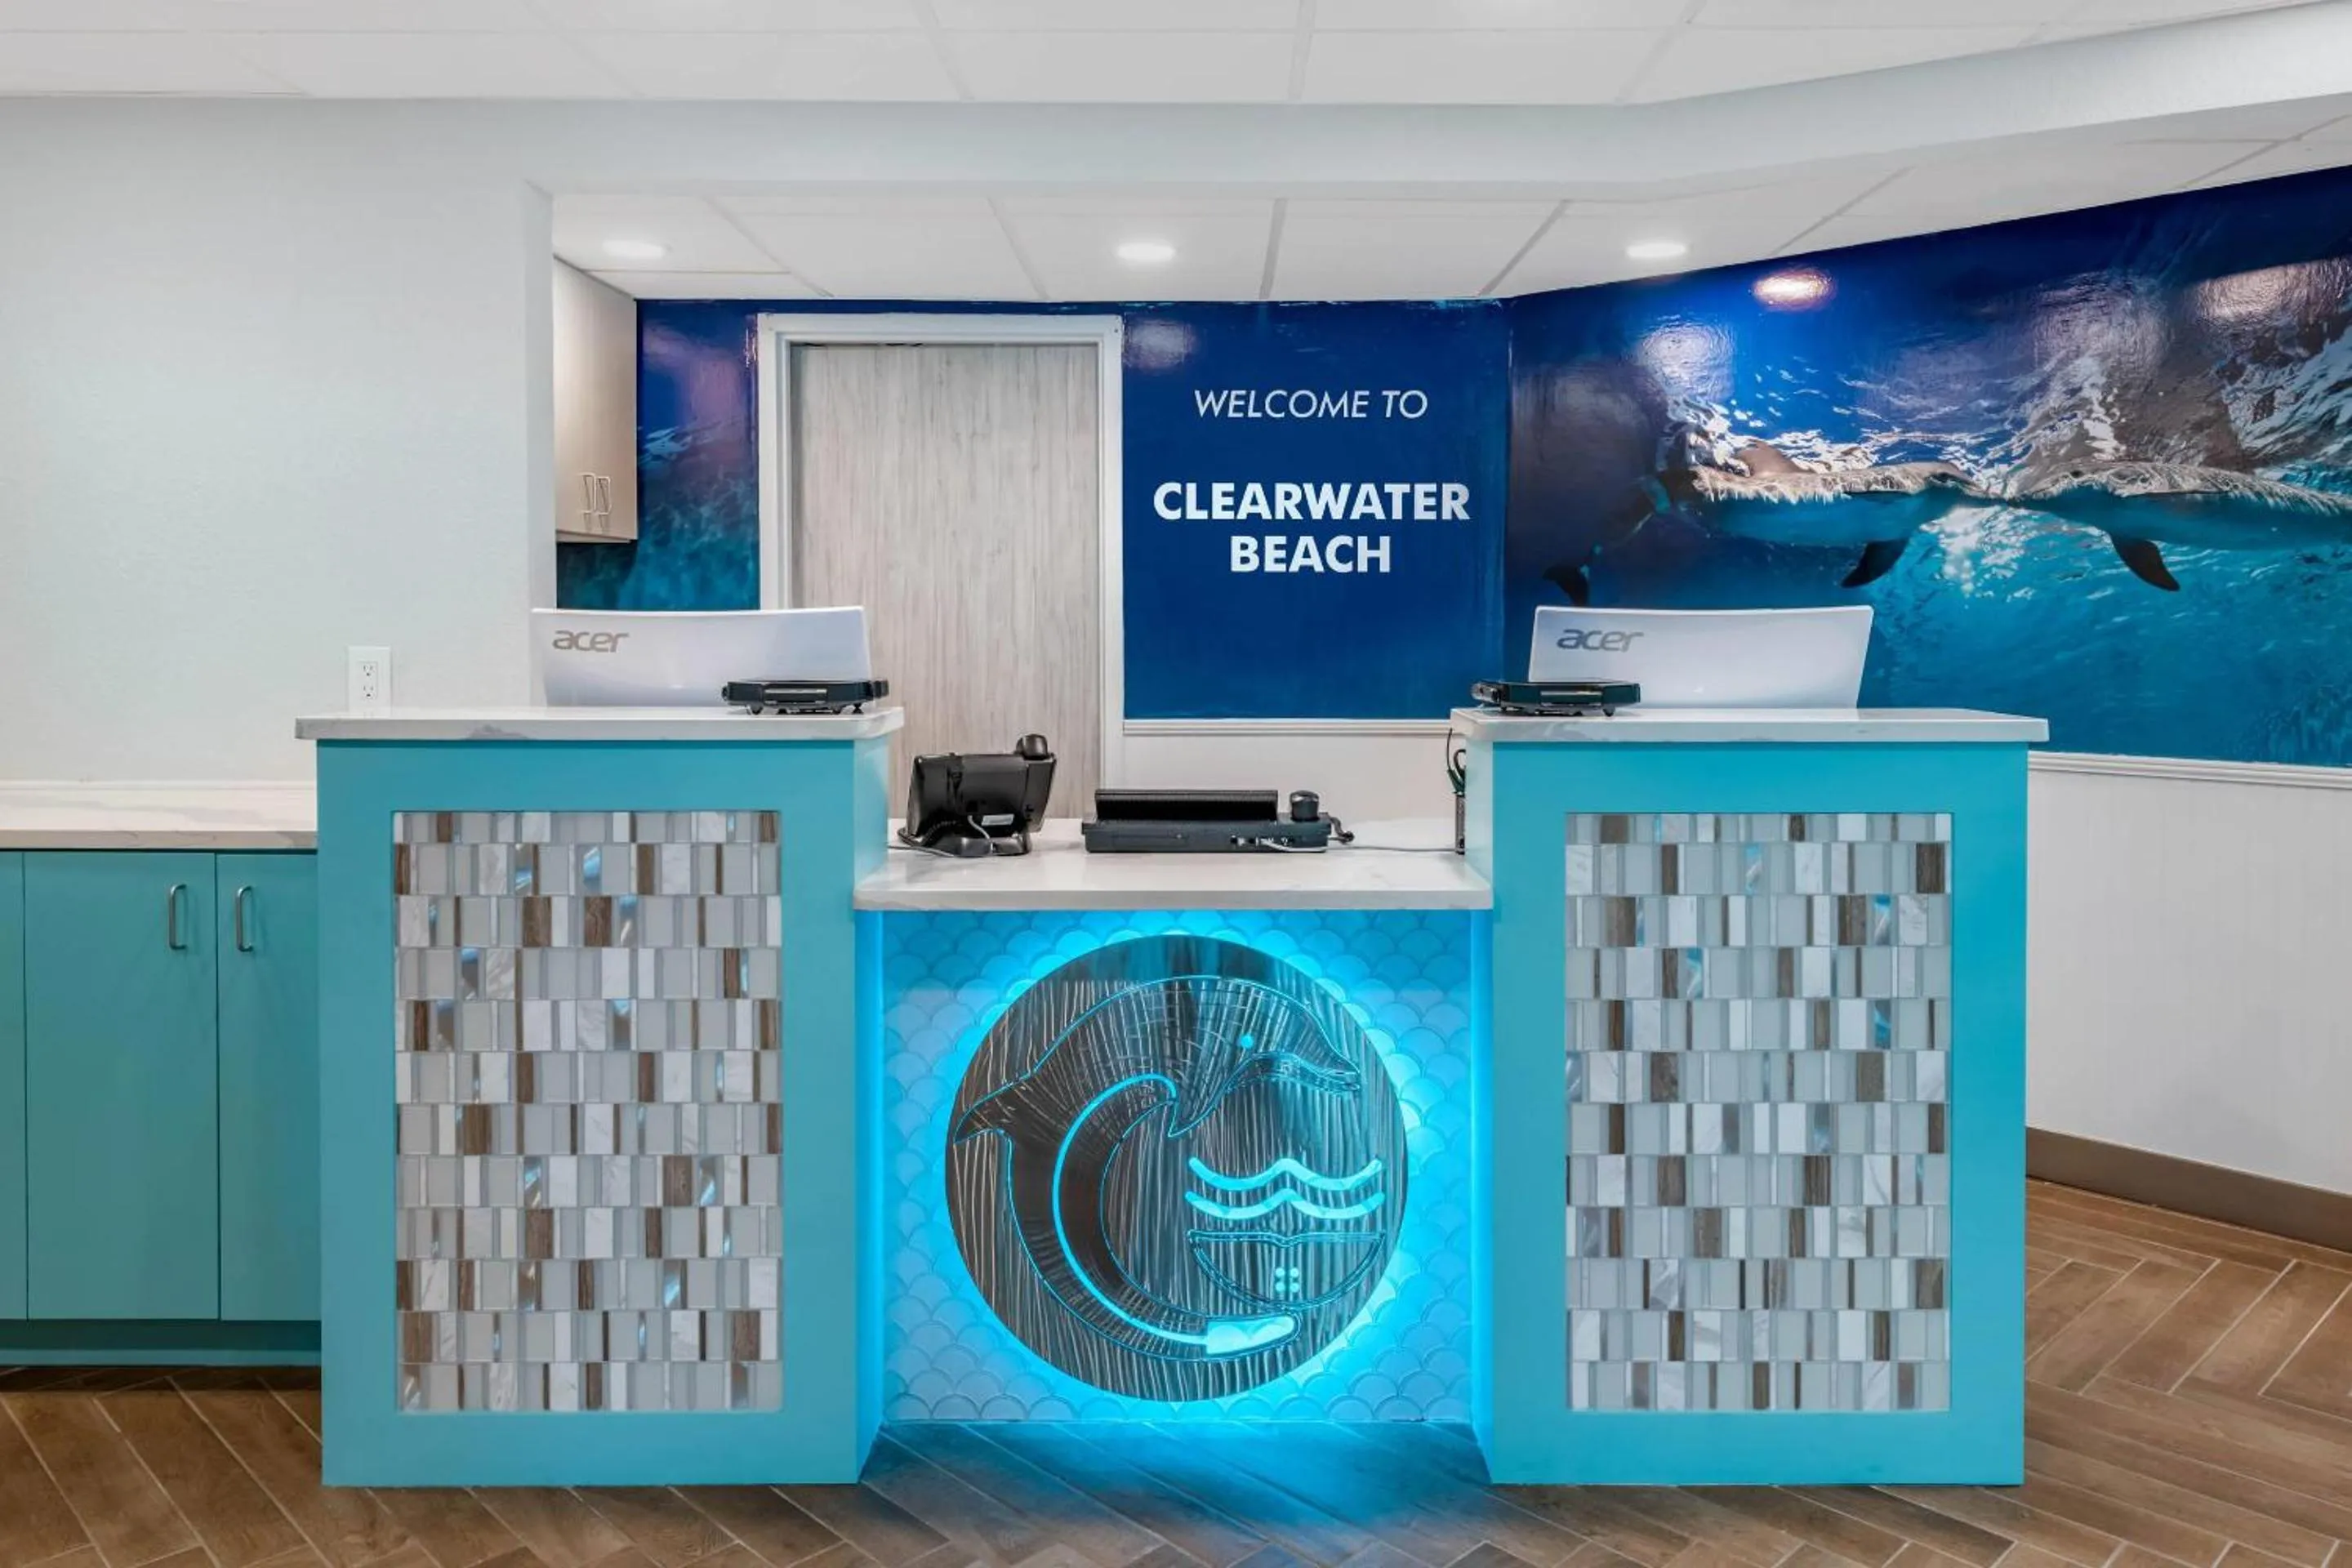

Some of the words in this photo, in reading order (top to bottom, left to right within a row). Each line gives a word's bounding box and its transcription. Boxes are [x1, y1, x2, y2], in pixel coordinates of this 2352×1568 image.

[1195, 390, 1370, 418] WELCOME
[1382, 390, 1428, 418] TO
[1153, 482, 1470, 520] CLEARWATER
[1231, 535, 1391, 572] BEACH
[553, 630, 629, 653] acer
[1557, 628, 1644, 653] acer
